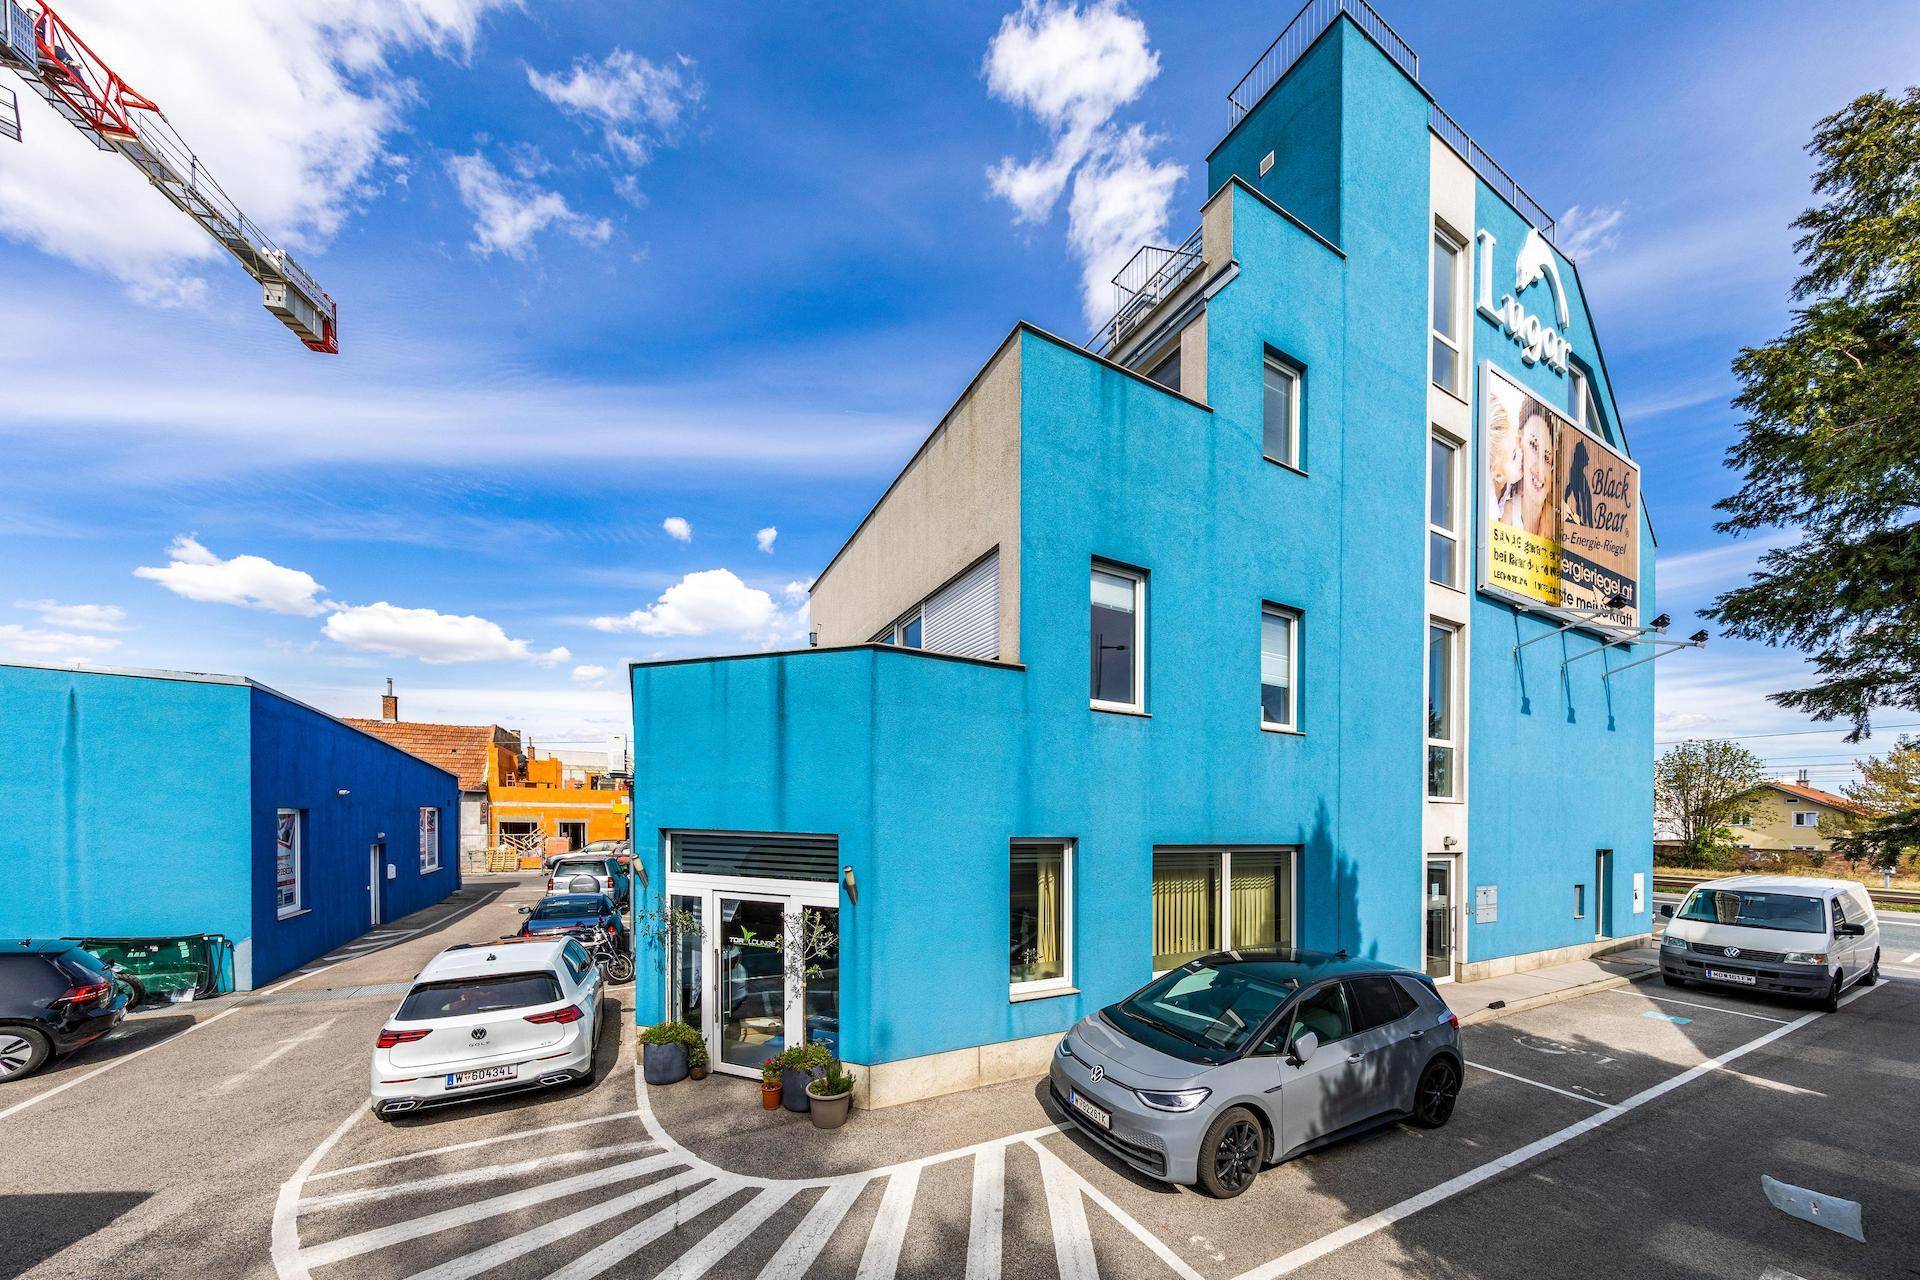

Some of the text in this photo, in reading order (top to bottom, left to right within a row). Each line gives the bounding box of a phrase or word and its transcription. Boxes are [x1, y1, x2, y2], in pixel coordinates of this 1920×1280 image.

[1476, 228, 1572, 376] Lugar
[1591, 467, 1631, 508] Black
[1594, 502, 1627, 533] Bear
